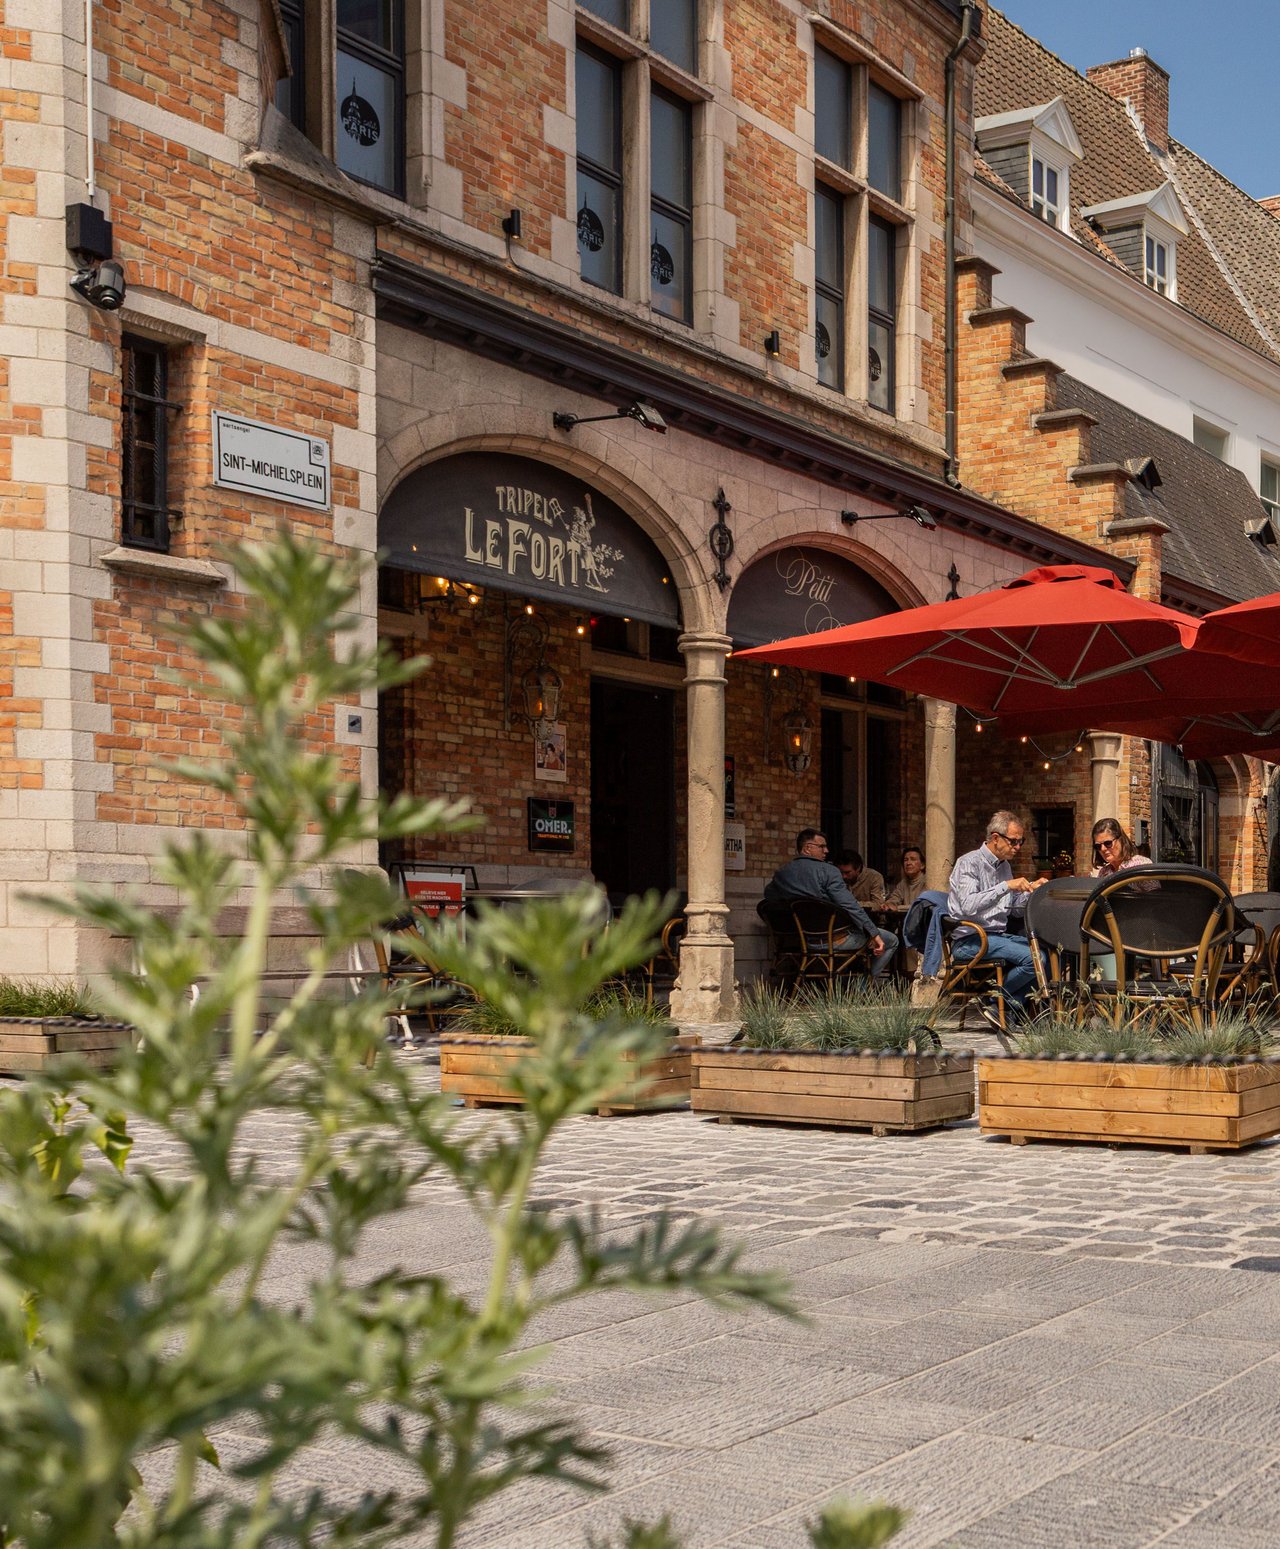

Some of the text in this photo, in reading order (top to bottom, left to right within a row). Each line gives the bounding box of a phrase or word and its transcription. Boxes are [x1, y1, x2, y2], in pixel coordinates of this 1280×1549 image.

[343, 117, 378, 141] PARIS
[653, 265, 673, 280] ARIS
[222, 422, 250, 433] aartsengel
[223, 452, 322, 490] SINT-MICHIELSPLEIN
[496, 486, 553, 527] TRIPEL
[776, 550, 838, 603] Petit
[725, 838, 743, 852] RTHA
